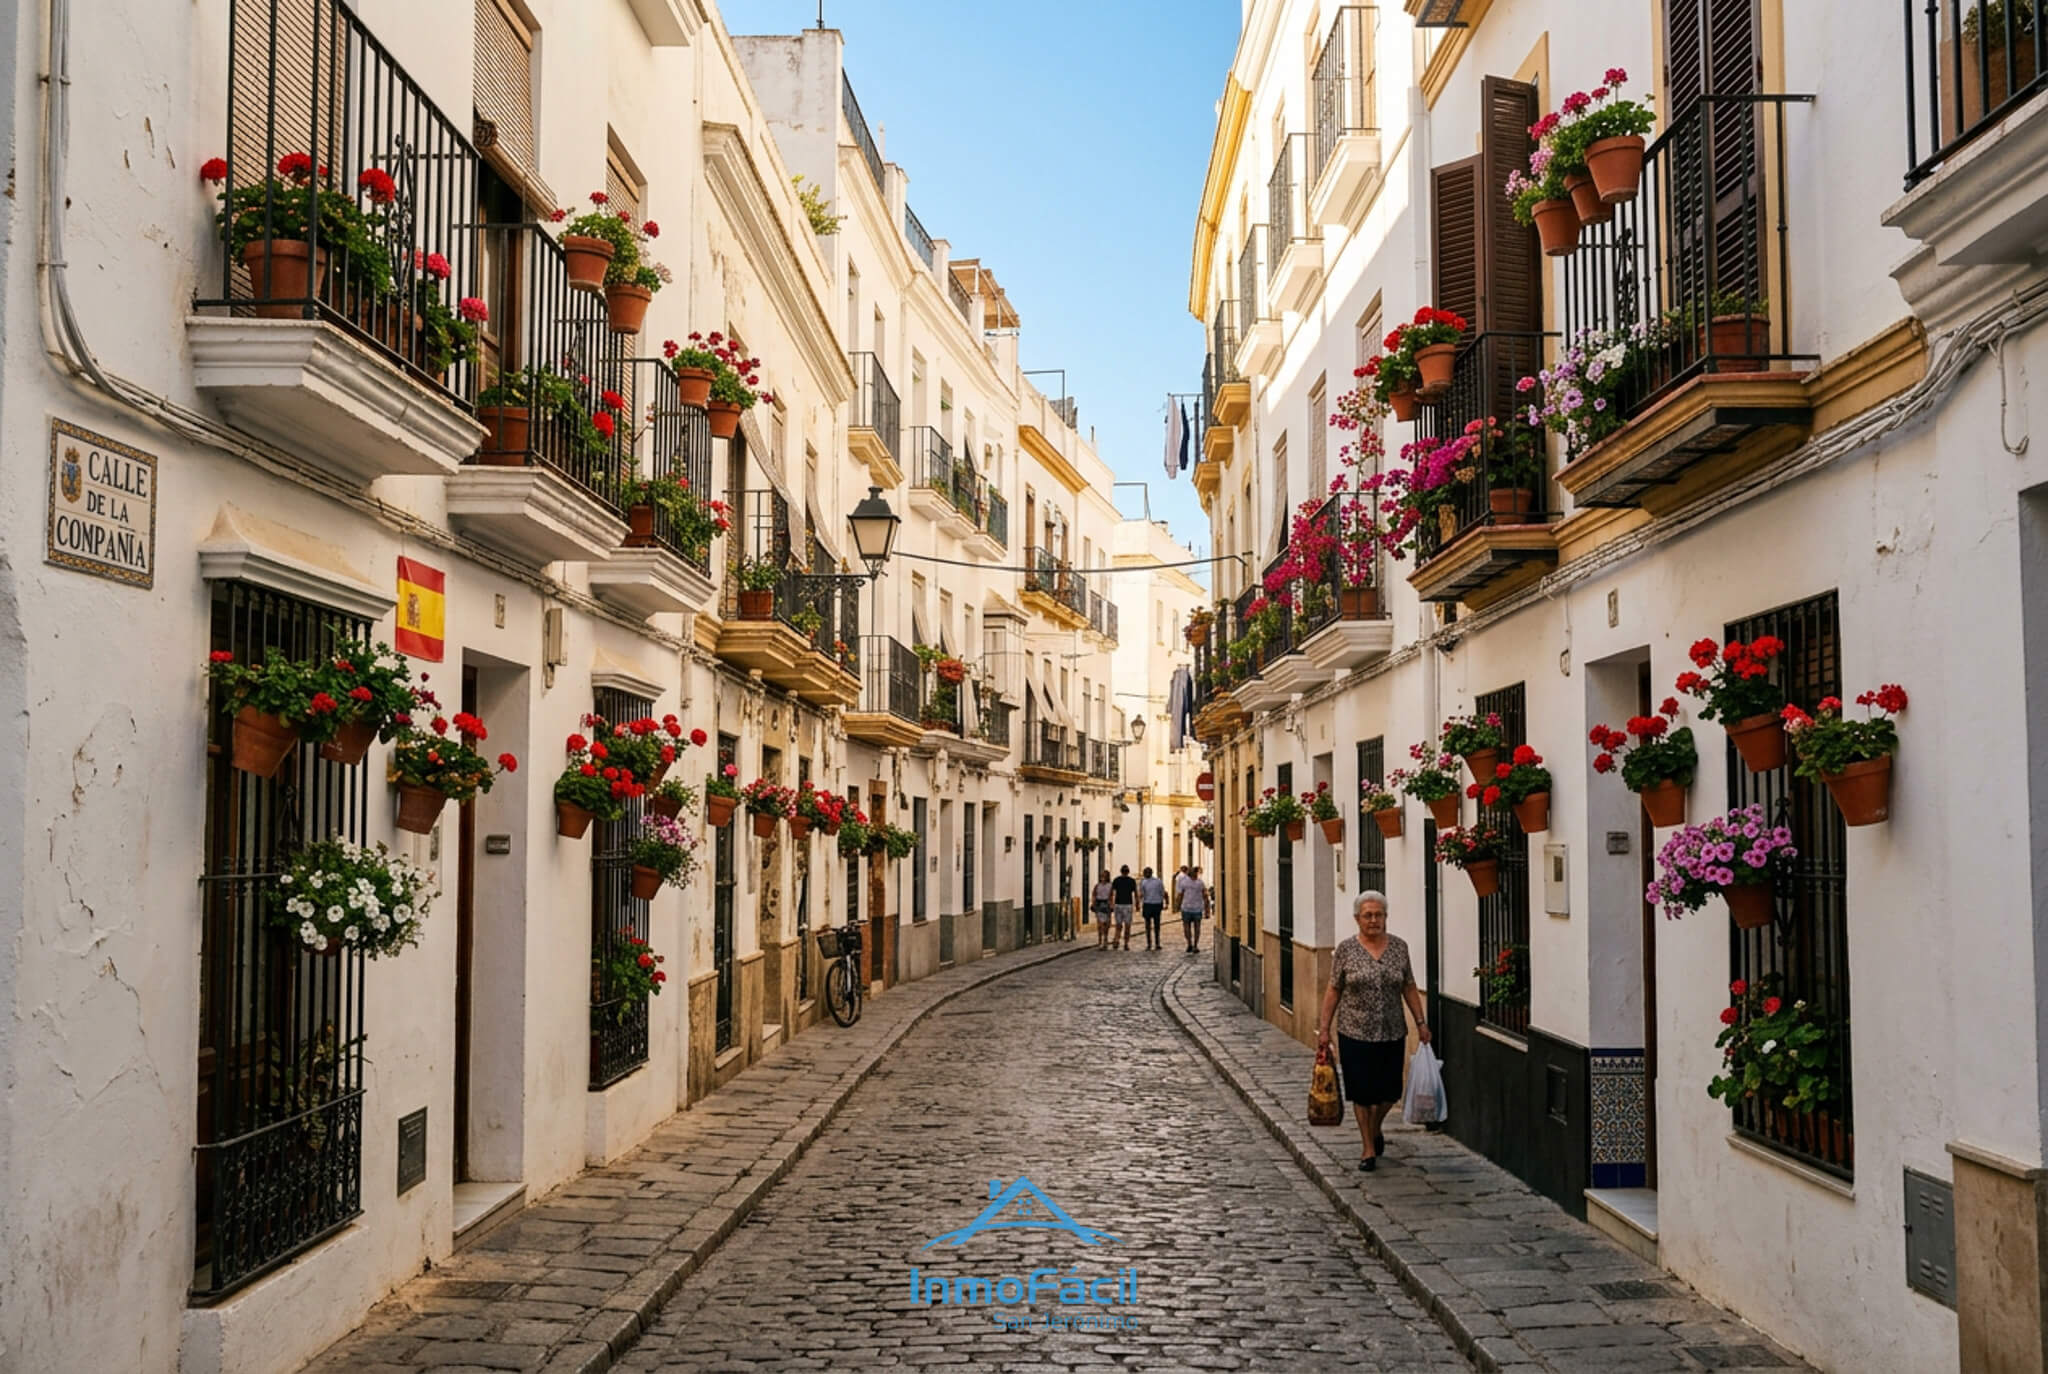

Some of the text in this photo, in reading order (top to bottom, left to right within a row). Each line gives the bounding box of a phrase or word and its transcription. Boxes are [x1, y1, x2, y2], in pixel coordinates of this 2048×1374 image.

[88, 451, 147, 498] CALLE
[87, 490, 129, 523] DE LA
